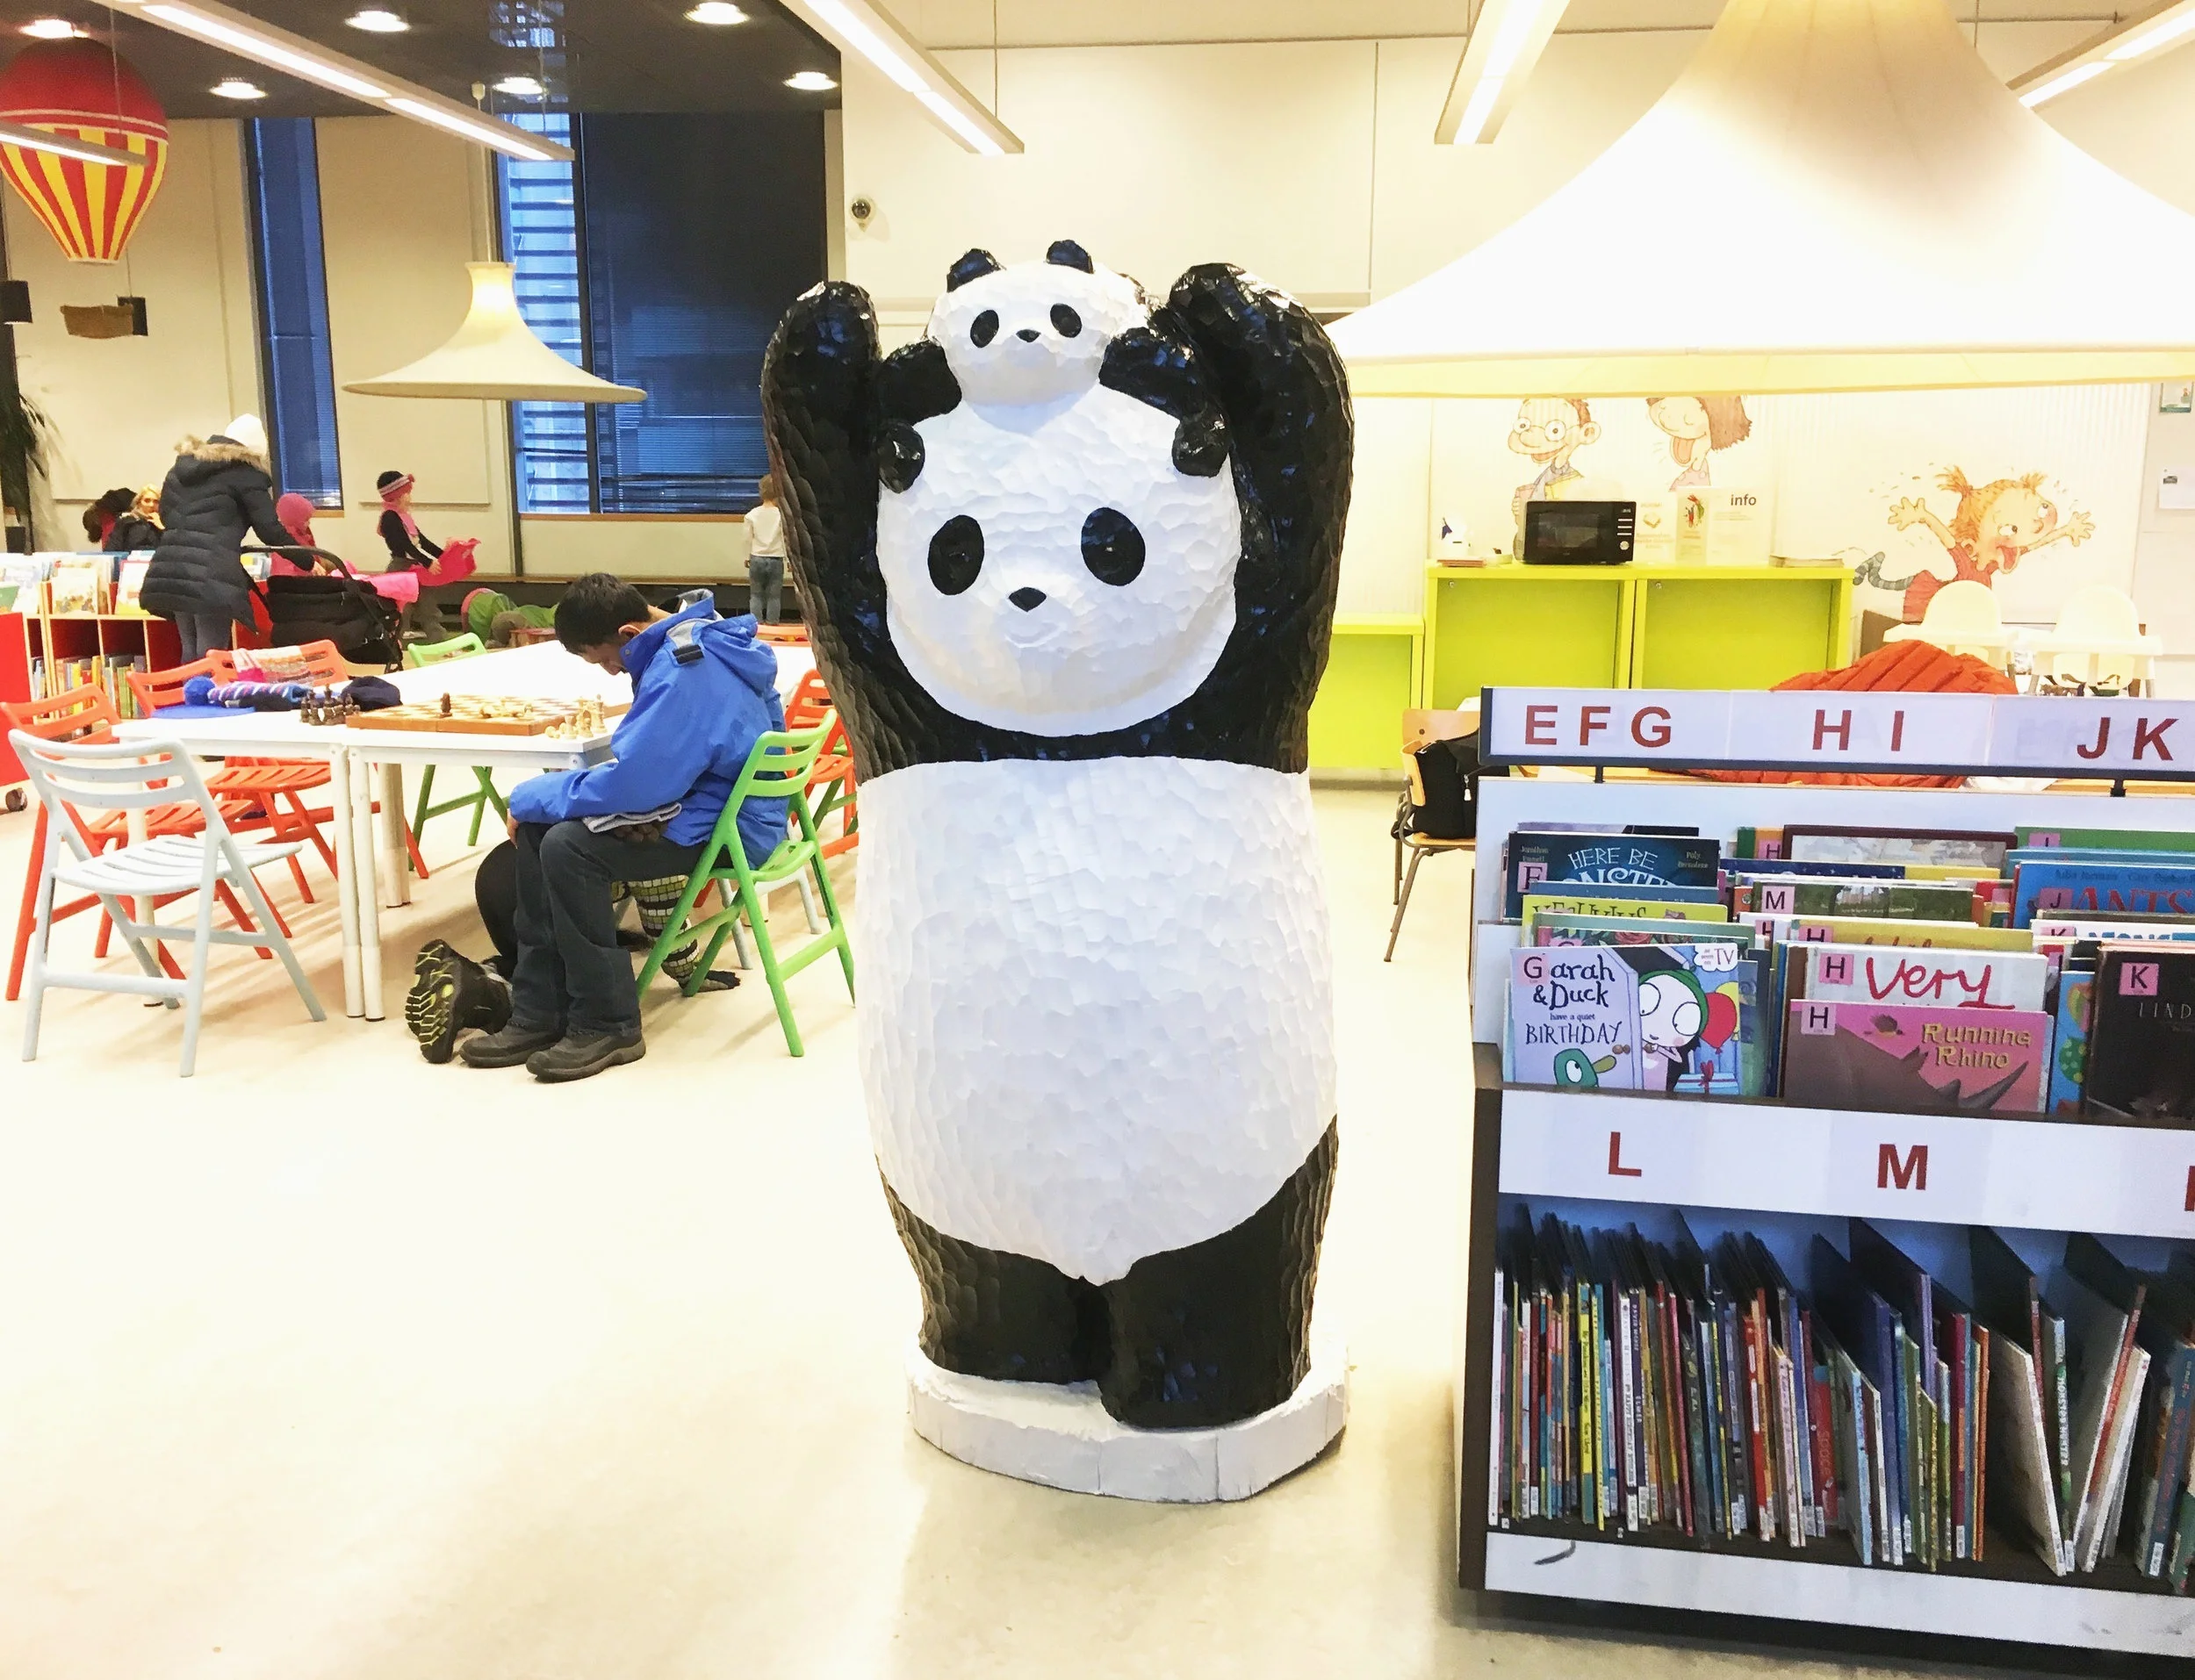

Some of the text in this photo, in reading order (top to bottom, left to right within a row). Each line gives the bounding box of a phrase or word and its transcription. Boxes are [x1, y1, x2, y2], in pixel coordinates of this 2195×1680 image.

[1731, 493, 1757, 506] info
[1525, 706, 1671, 747] E F G
[1813, 710, 1904, 751] H I
[2077, 717, 2174, 760] J K
[1567, 847, 1659, 871] HERE BE
[1766, 891, 1785, 910] M
[2050, 893, 2062, 908] J
[1523, 956, 1544, 980] G
[1714, 947, 1735, 965] TV
[1825, 956, 1846, 980] H
[1866, 957, 2016, 1010] Very
[2131, 966, 2149, 989] K
[1550, 1012, 1570, 1021] have
[1577, 1012, 1595, 1023] quiet
[1810, 1006, 1829, 1029] H
[1525, 1021, 1623, 1045] BIRTHDAY
[1922, 1023, 2032, 1048] Running
[1934, 1045, 2010, 1069] Rhino
[1609, 1132, 1640, 1176] L
[1877, 1144, 1927, 1188] M
